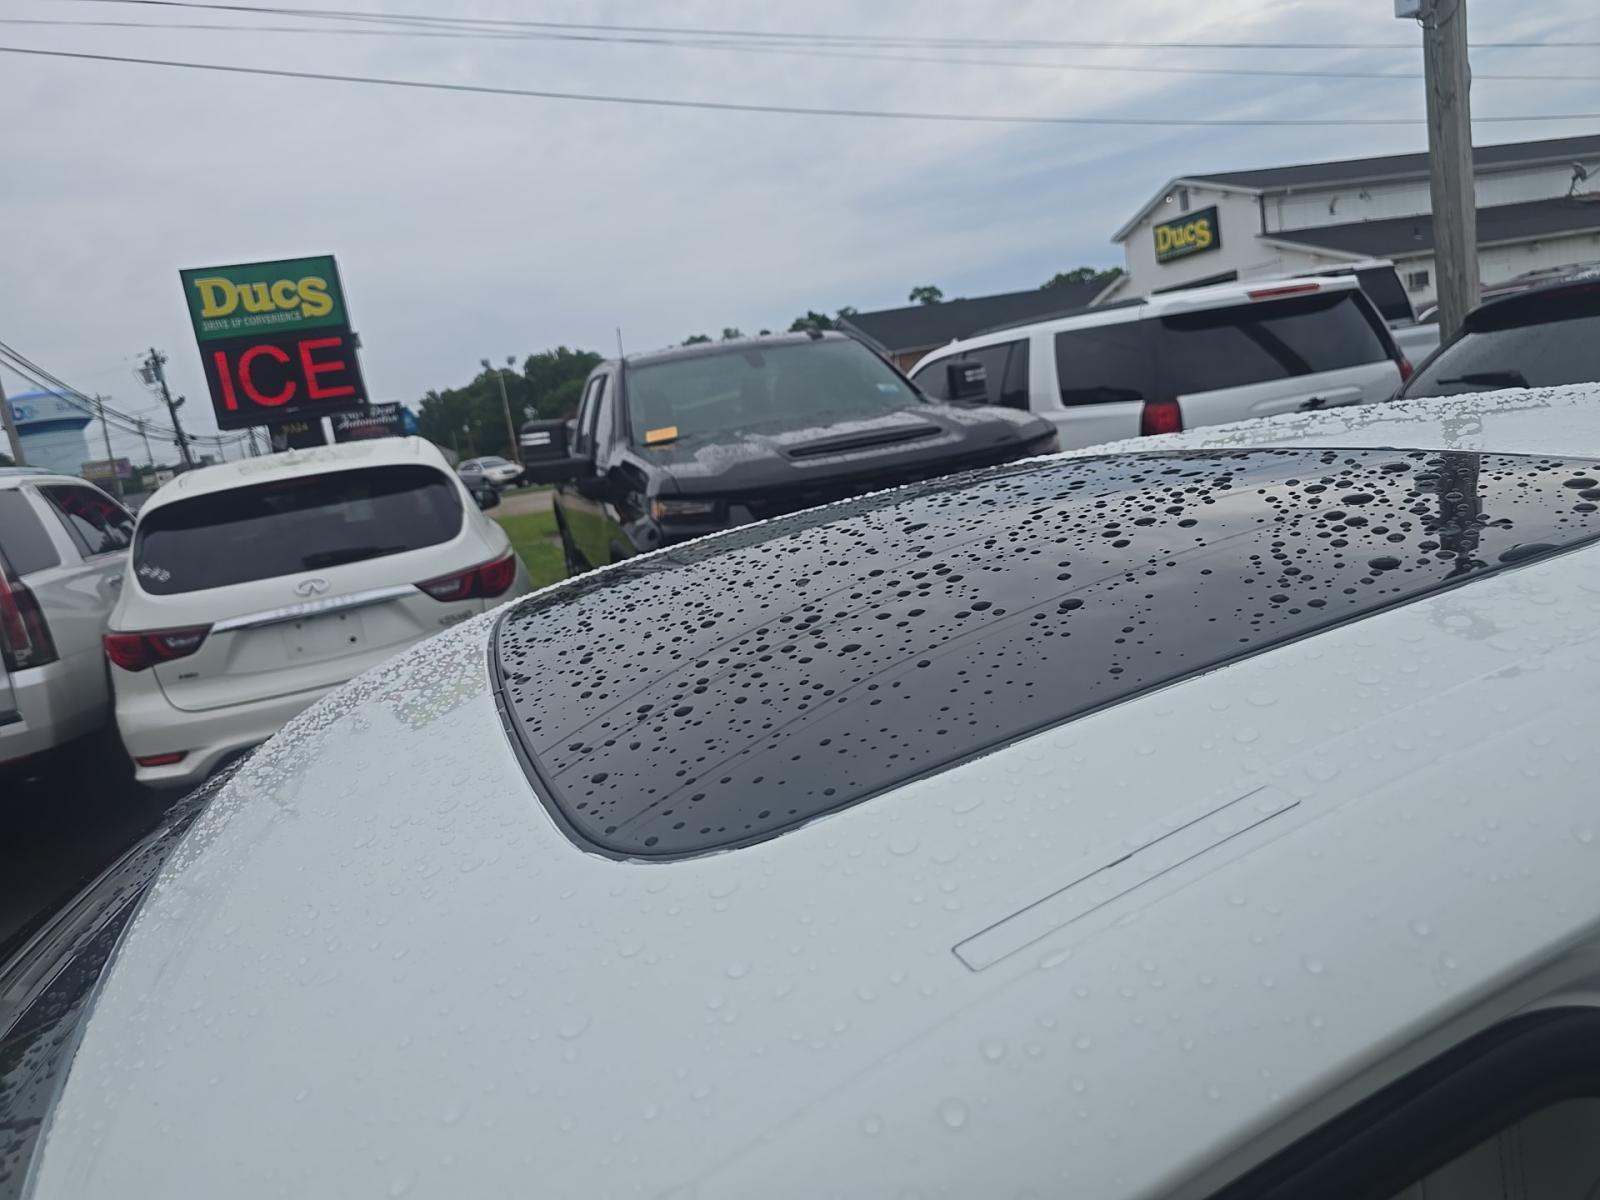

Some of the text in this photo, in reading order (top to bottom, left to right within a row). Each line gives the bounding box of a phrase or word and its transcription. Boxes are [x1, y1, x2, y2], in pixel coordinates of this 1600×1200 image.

[203, 311, 302, 332] DRIVE UP CONVENIENCE
[213, 336, 356, 411] ICE
